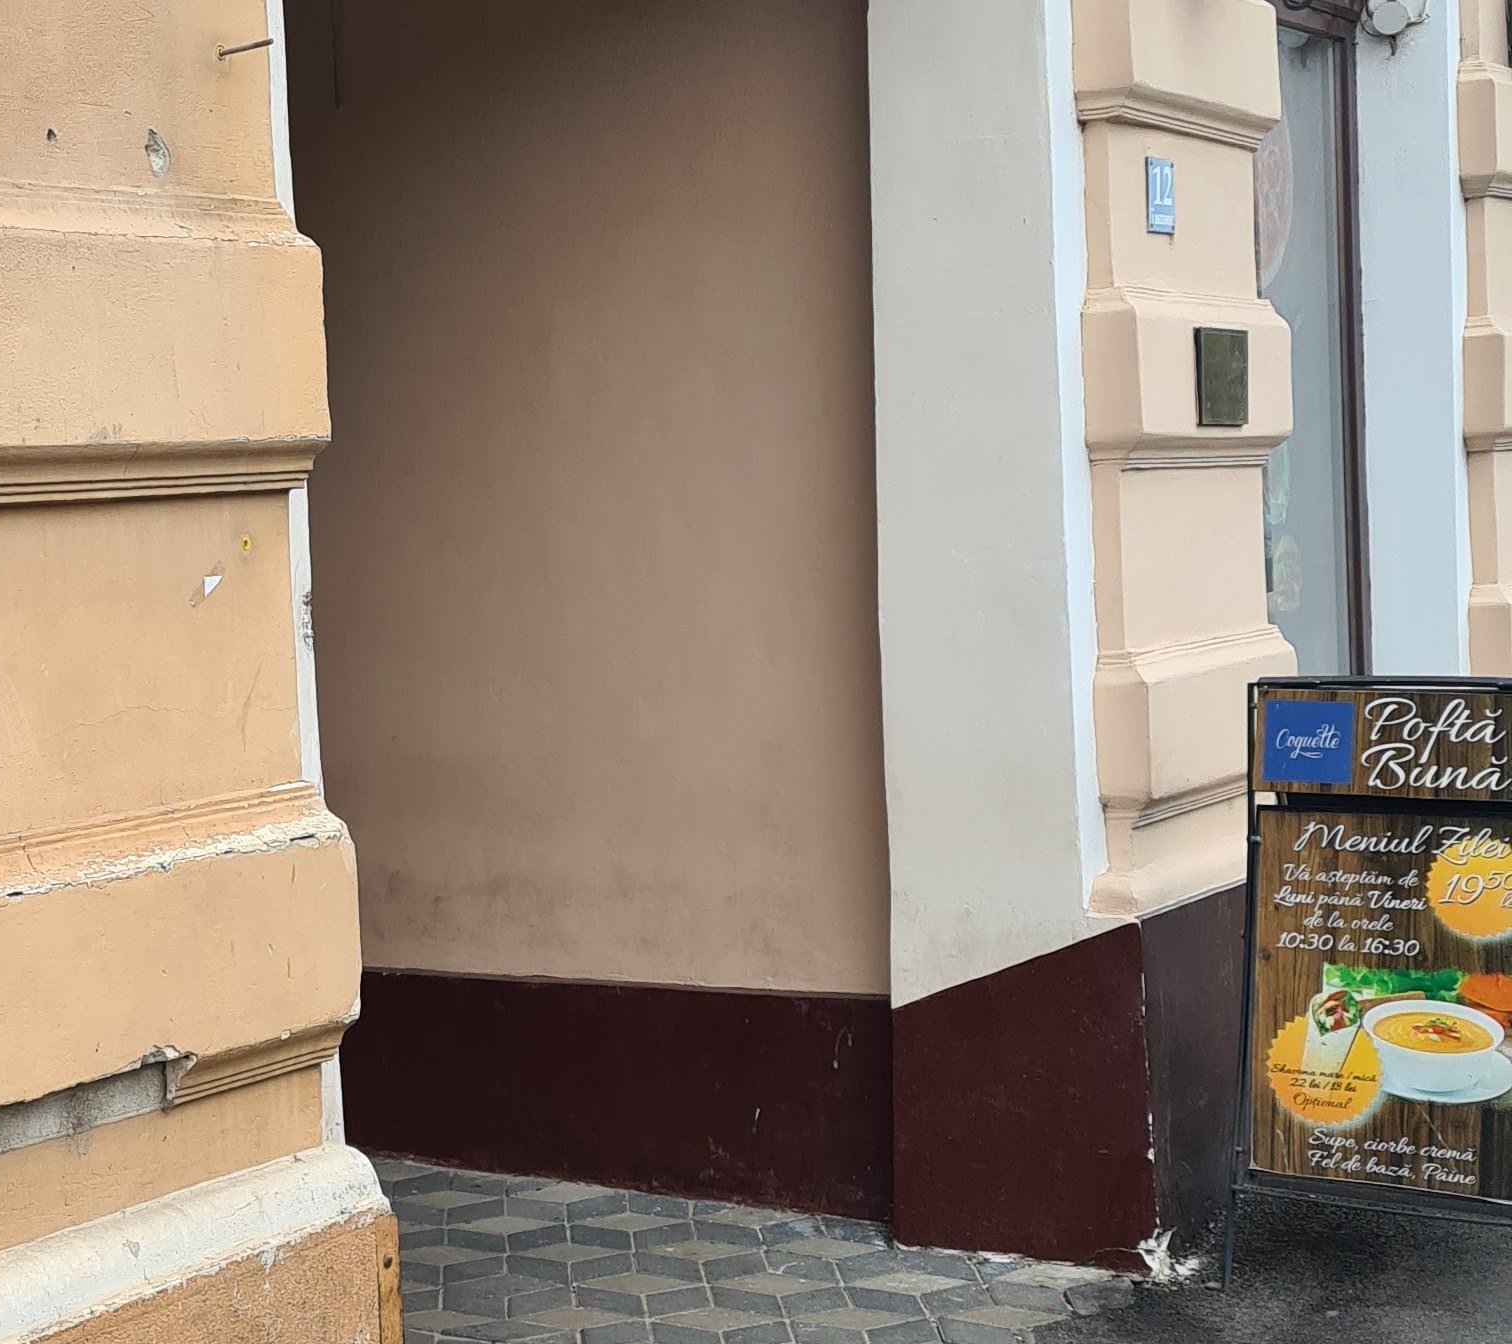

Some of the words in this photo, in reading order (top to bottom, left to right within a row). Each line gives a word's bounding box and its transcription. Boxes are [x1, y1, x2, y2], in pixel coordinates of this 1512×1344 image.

[1152, 165, 1173, 206] 12
[1364, 697, 1507, 764] Poftă
[1361, 742, 1512, 791] Bună
[1293, 821, 1434, 854] Meniul
[1432, 825, 1512, 866] Zilei
[1283, 863, 1312, 882] Vă
[1398, 869, 1420, 889] de
[1274, 885, 1316, 907] Luni
[1314, 892, 1364, 912] până
[1367, 890, 1428, 911] Vineri
[1303, 909, 1324, 930] de
[1328, 911, 1347, 929] la
[1351, 914, 1394, 932] orele
[1276, 931, 1334, 951] 10:30
[1339, 935, 1358, 952] la
[1360, 937, 1420, 957] 16:30
[1290, 1077, 1307, 1088] 22
[1308, 1127, 1359, 1154] Supe,
[1363, 1136, 1417, 1156] ciorbe
[1420, 1147, 1477, 1162] cremă
[1308, 1150, 1343, 1168] Fel
[1341, 1154, 1362, 1173] de
[1422, 1163, 1477, 1186] Pâine
